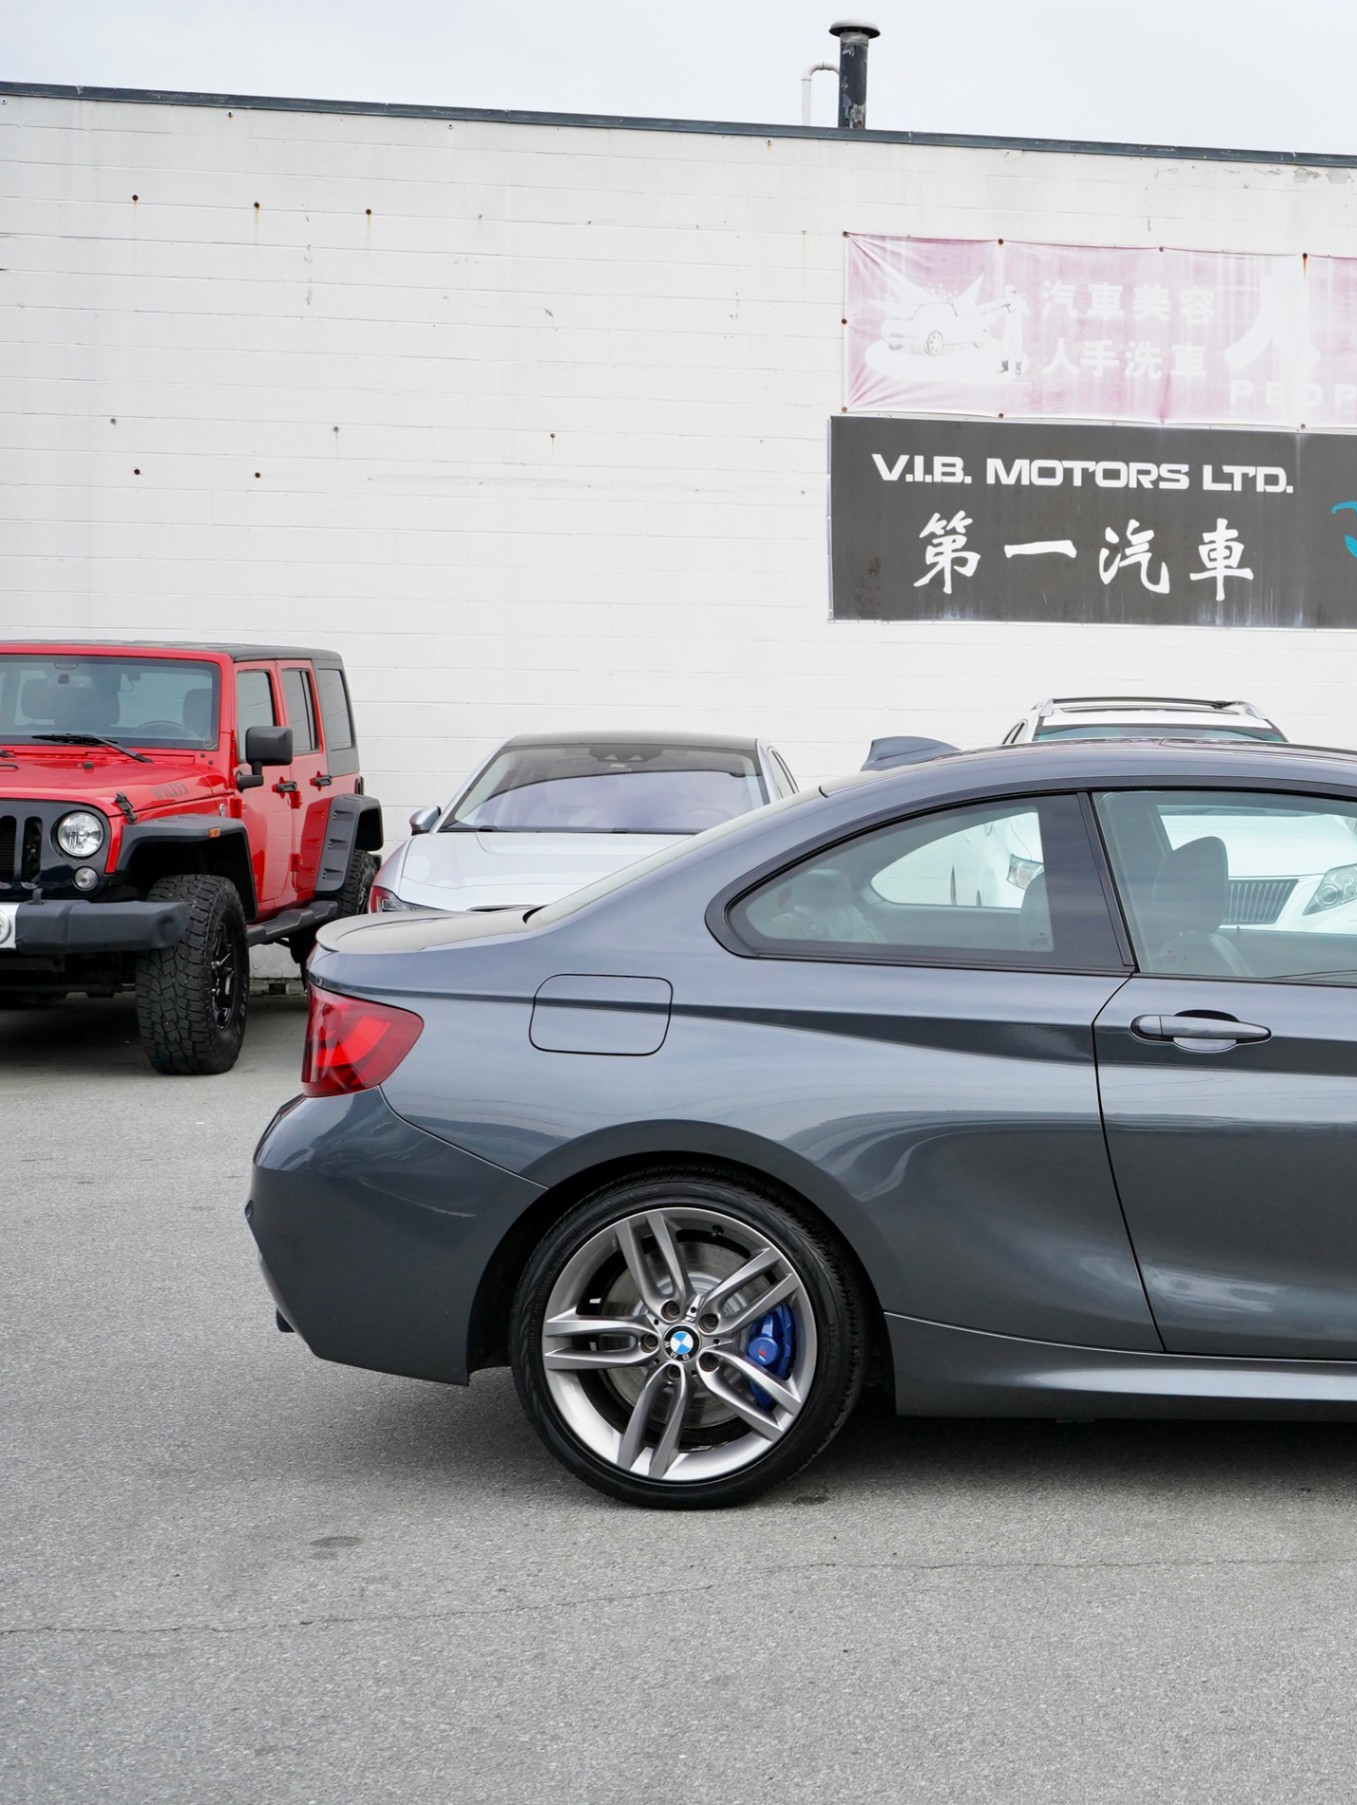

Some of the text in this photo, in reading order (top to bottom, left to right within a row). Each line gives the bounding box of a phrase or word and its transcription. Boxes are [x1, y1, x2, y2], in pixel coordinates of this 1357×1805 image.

[1041, 280, 1215, 326] 汽車美容
[1043, 337, 1208, 381] 人手洗車
[872, 453, 1294, 494] V.I.B. MOTORS LTD.
[913, 510, 1254, 601] 第一汽車
